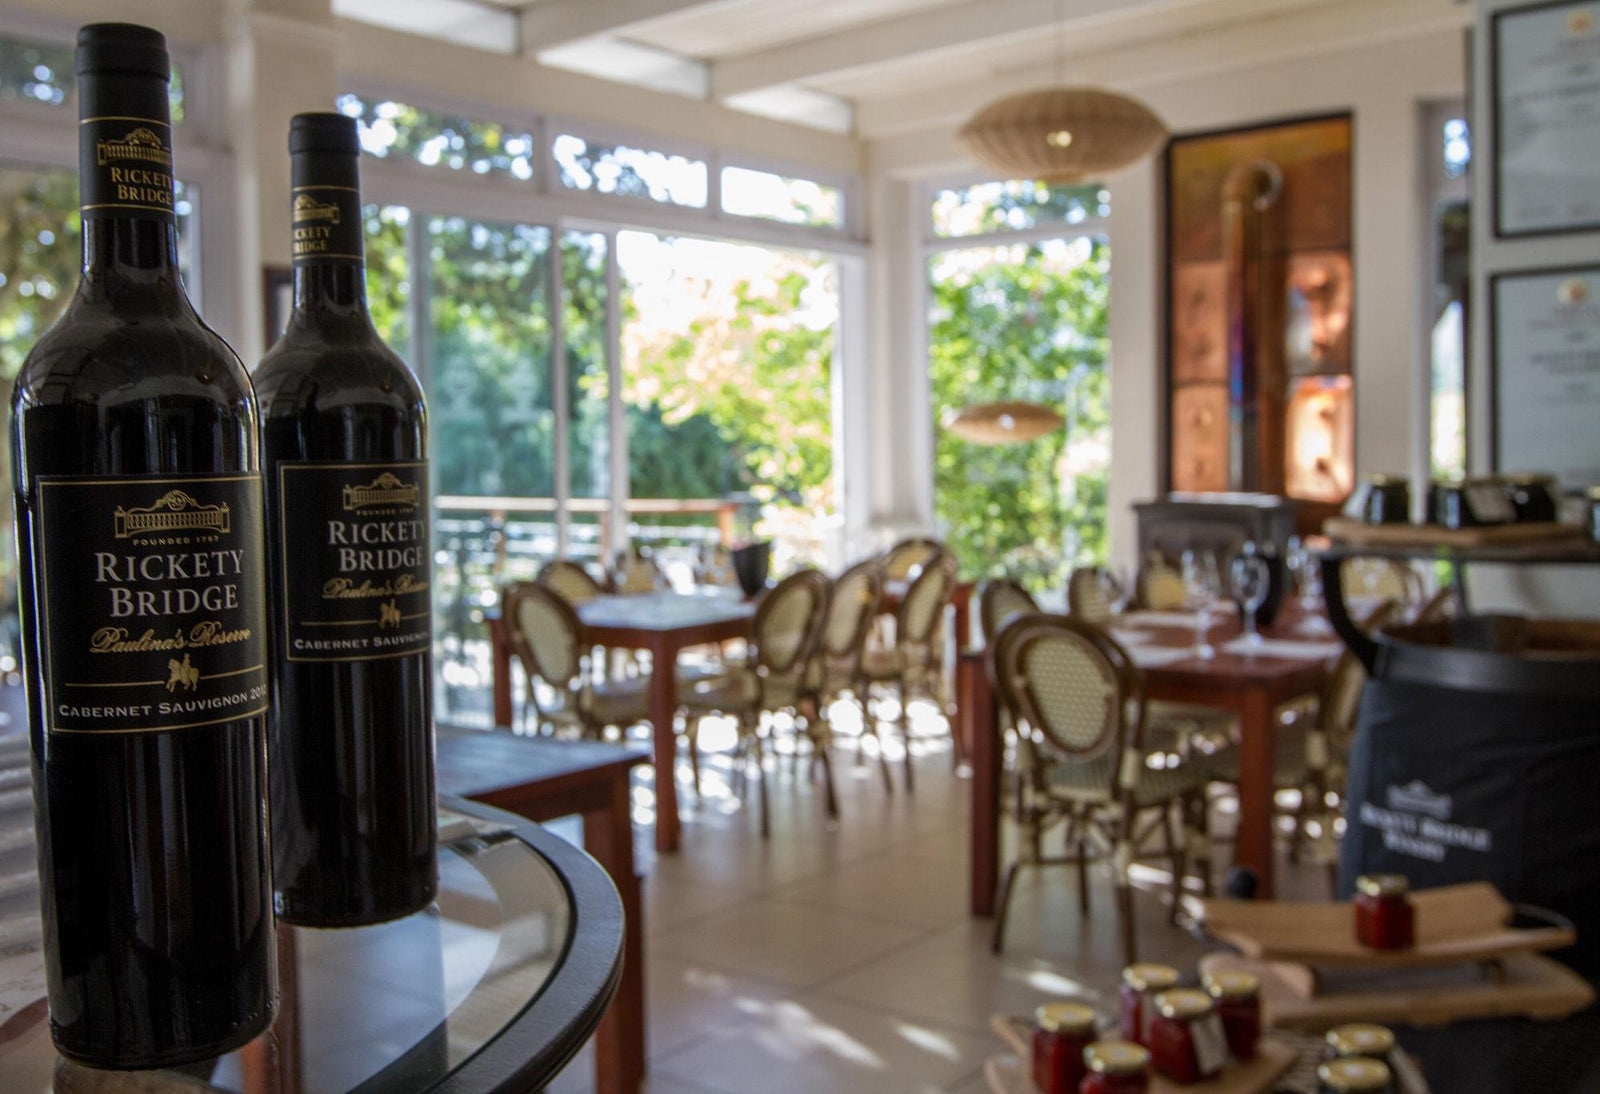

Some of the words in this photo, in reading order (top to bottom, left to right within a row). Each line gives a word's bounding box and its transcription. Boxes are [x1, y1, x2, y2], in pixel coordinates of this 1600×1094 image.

[94, 550, 243, 582] RICKETY
[340, 547, 424, 572] BRIDGE
[109, 584, 239, 617] BRIDGE
[89, 626, 185, 653] Paulina's
[187, 621, 251, 648] Reserve
[294, 638, 369, 650] CABERNET
[59, 704, 152, 718] CABERNET
[158, 692, 248, 715] SAUVIGNON
